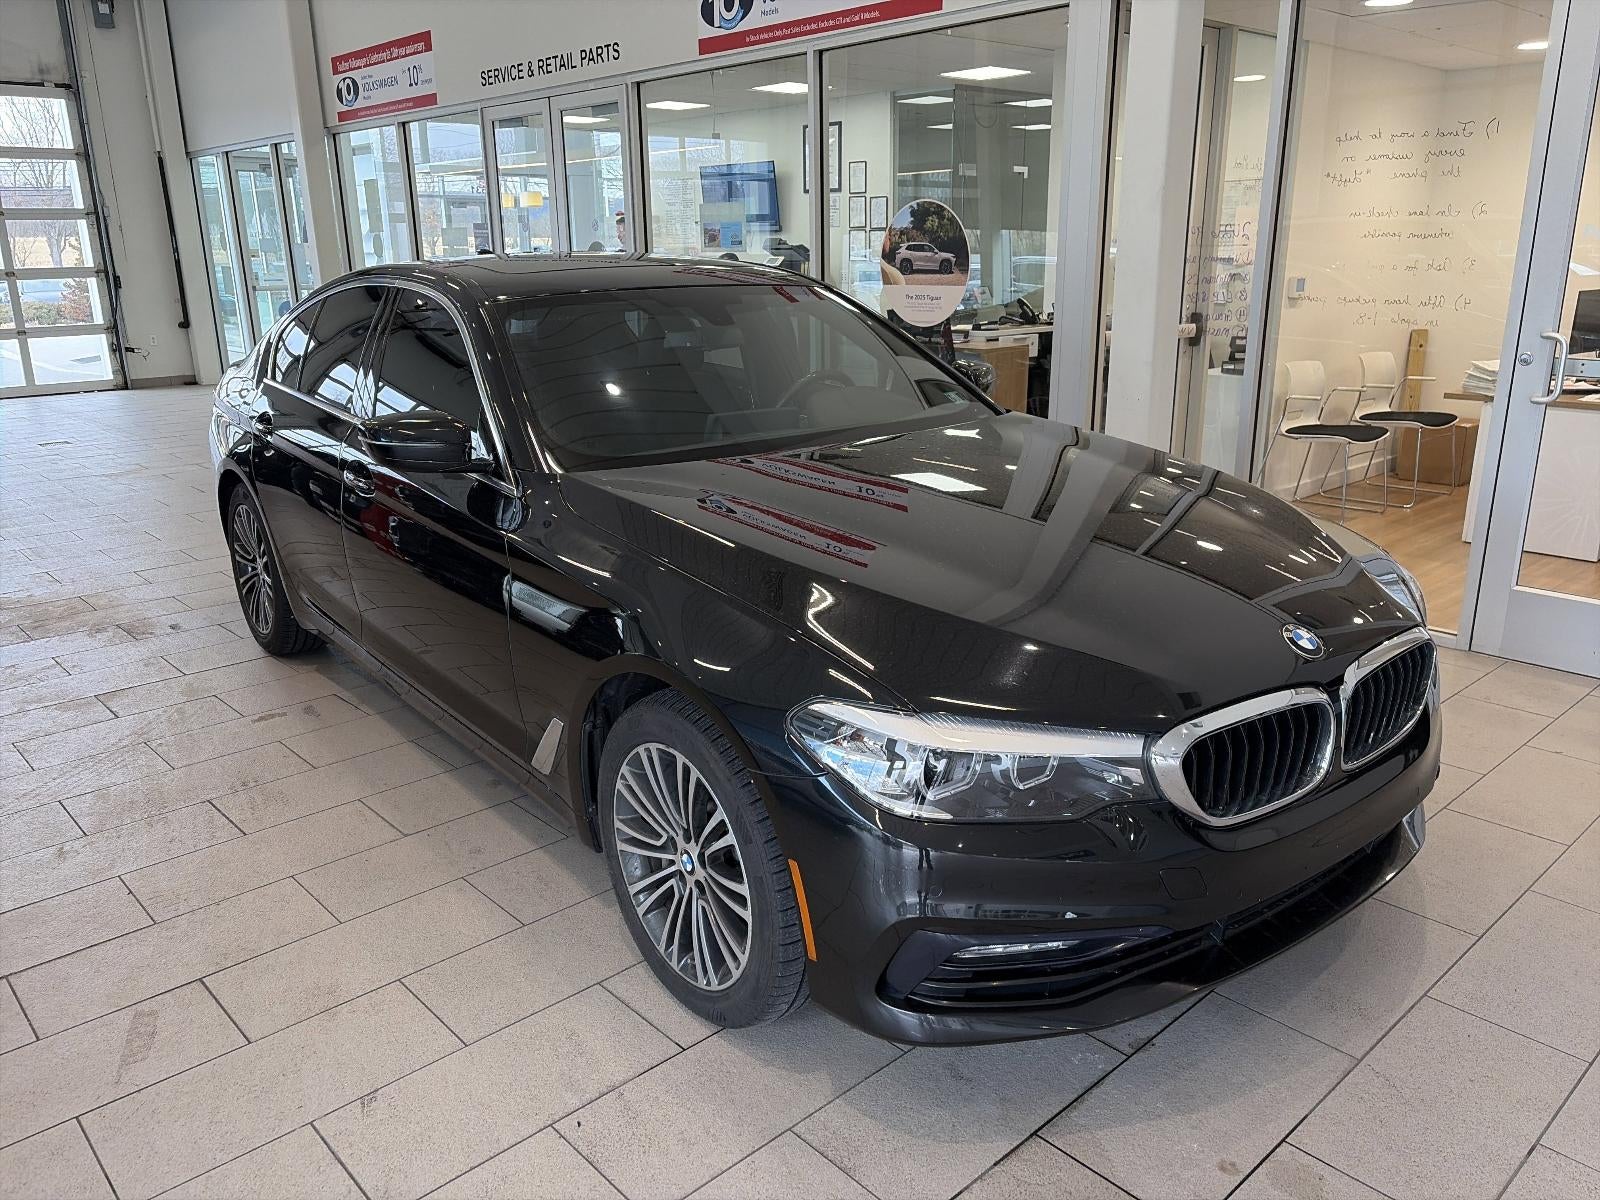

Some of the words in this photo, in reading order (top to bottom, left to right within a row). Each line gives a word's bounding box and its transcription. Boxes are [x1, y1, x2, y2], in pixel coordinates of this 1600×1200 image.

[480, 62, 524, 87] SERVICE
[527, 60, 535, 78] &
[537, 51, 577, 76] RETAIL
[580, 41, 620, 68] PARTS
[361, 75, 399, 92] VOLKSWAGEN
